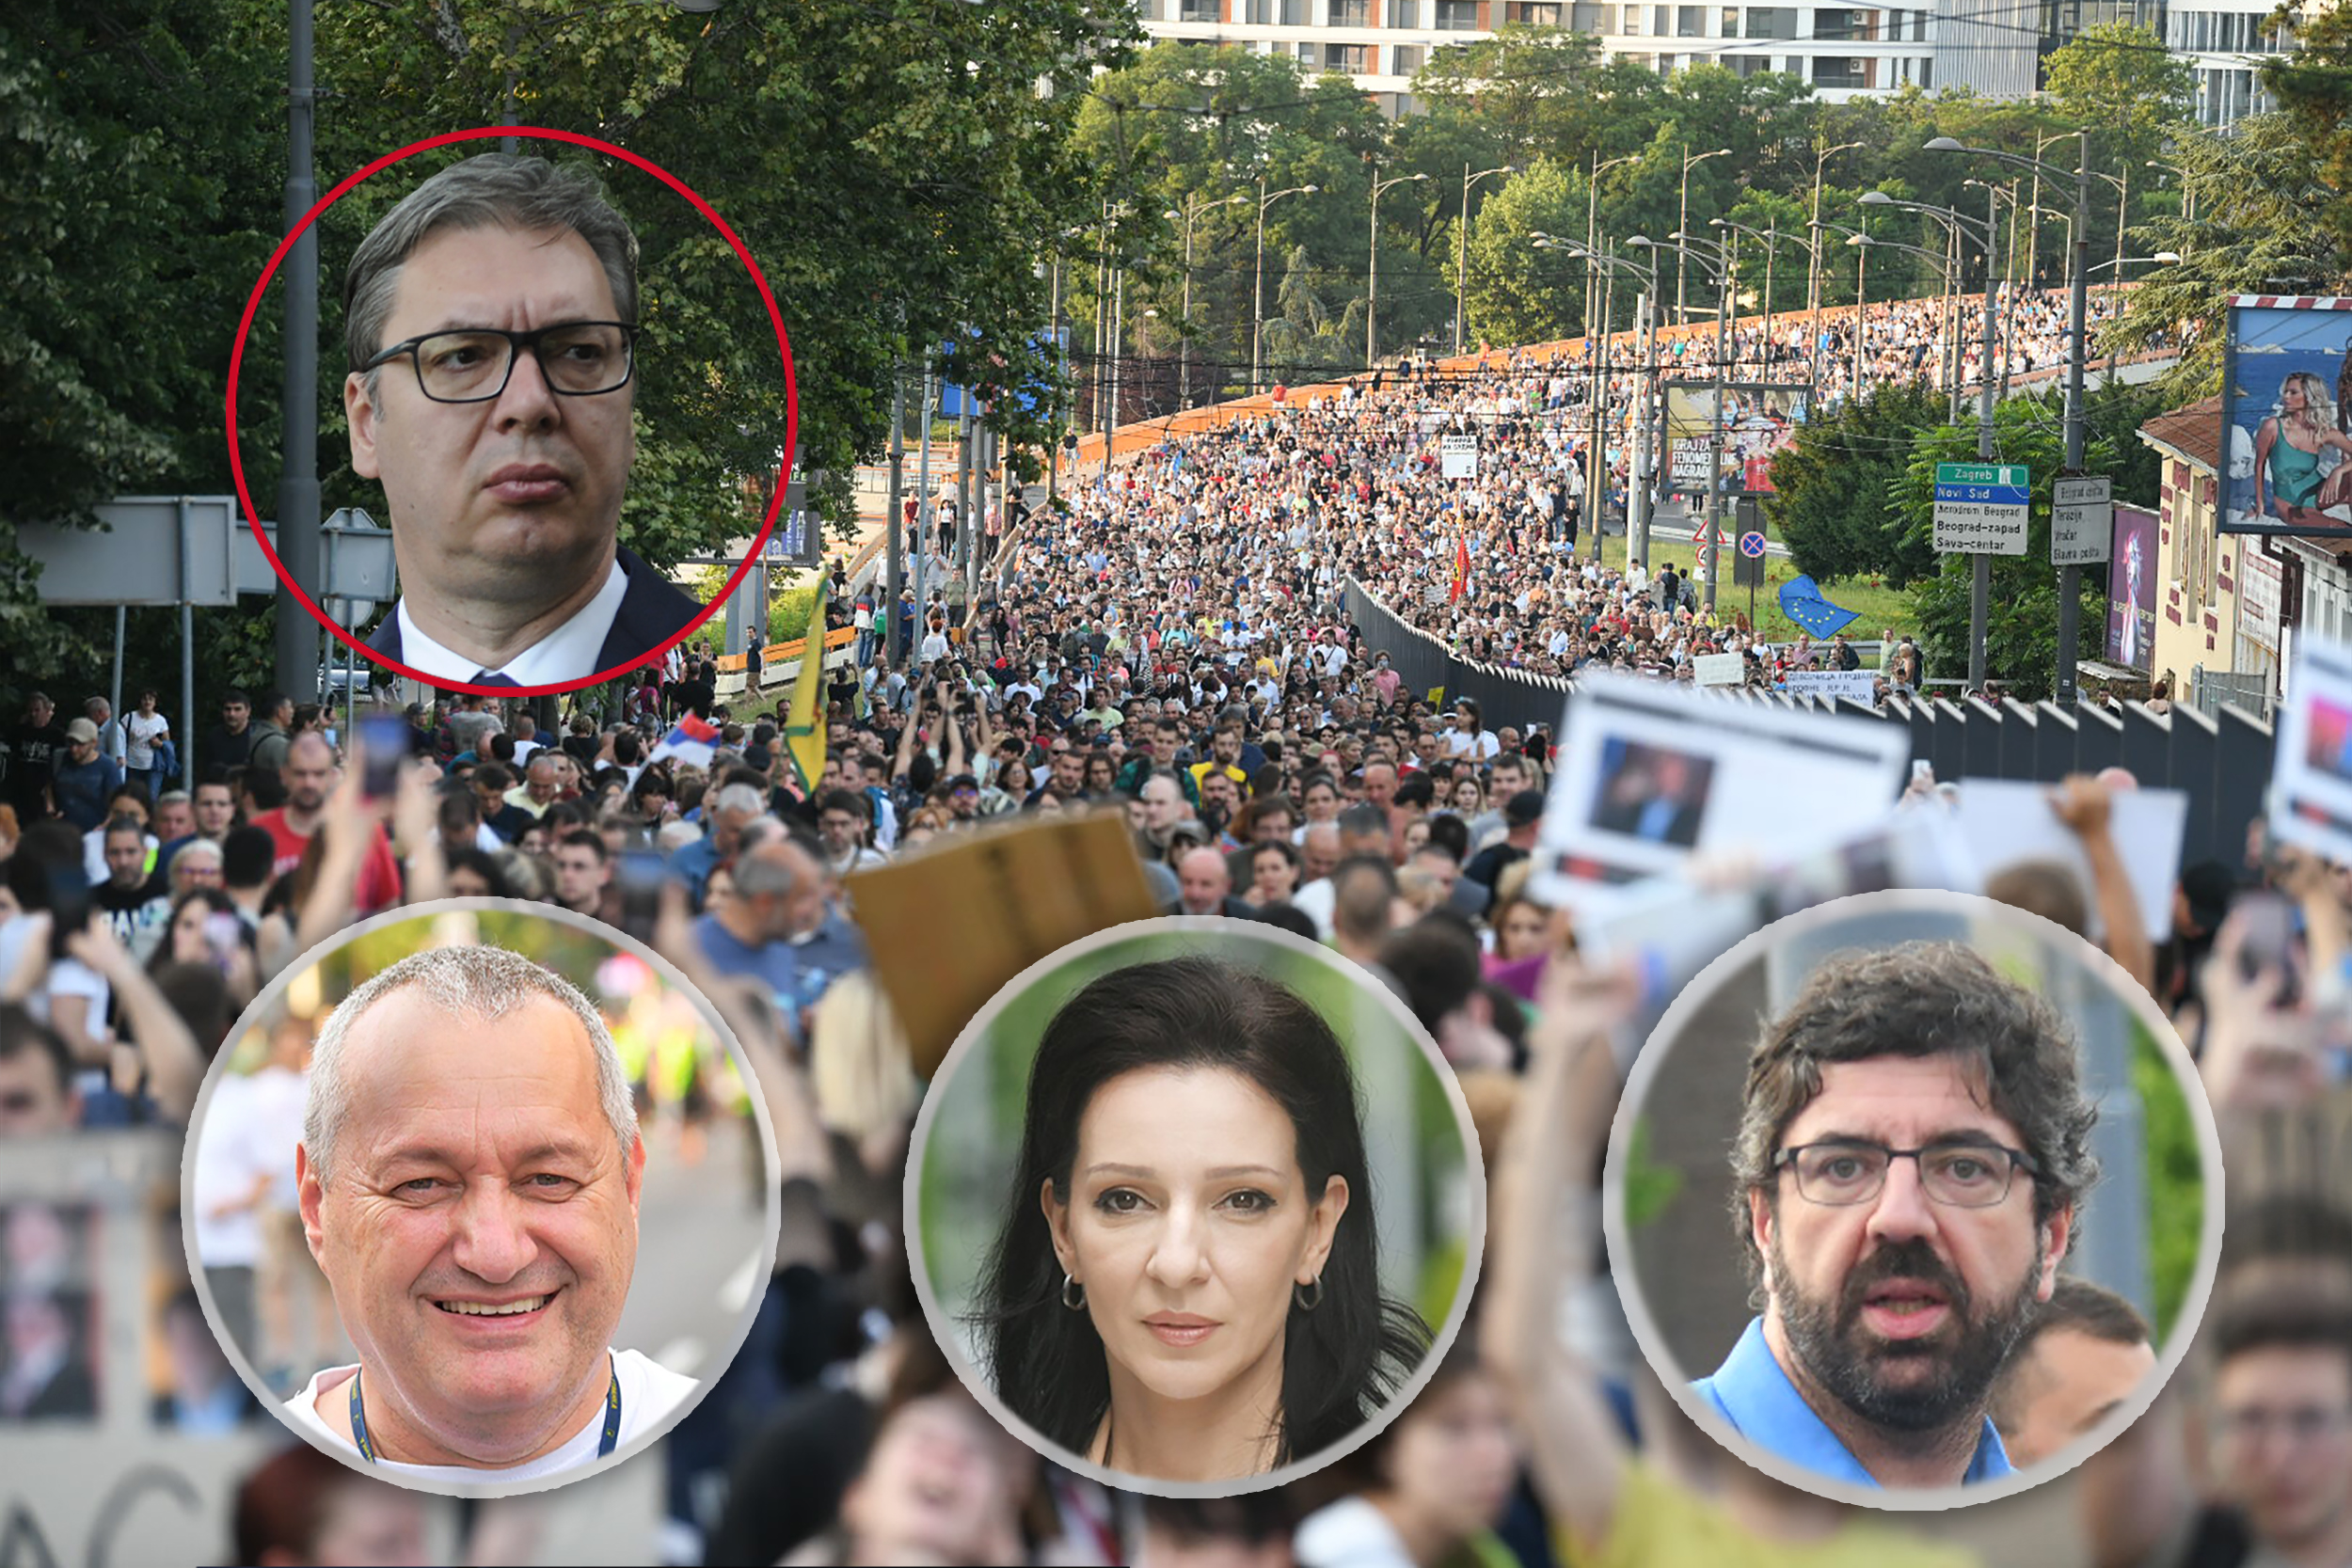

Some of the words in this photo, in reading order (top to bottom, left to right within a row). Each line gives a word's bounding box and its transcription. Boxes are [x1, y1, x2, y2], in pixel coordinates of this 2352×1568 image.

[1699, 438, 1711, 451] ZA
[1673, 465, 1711, 477] NAGRAD
[1955, 468, 1993, 481] Zagreb
[1938, 487, 1962, 497] Novi
[1968, 488, 1990, 499] Sad
[1937, 505, 1979, 515] Aerodrom
[1984, 506, 2020, 518] Beograd
[1937, 521, 2020, 534] Beograd-zapad
[1937, 537, 2005, 549] Sava-centar
